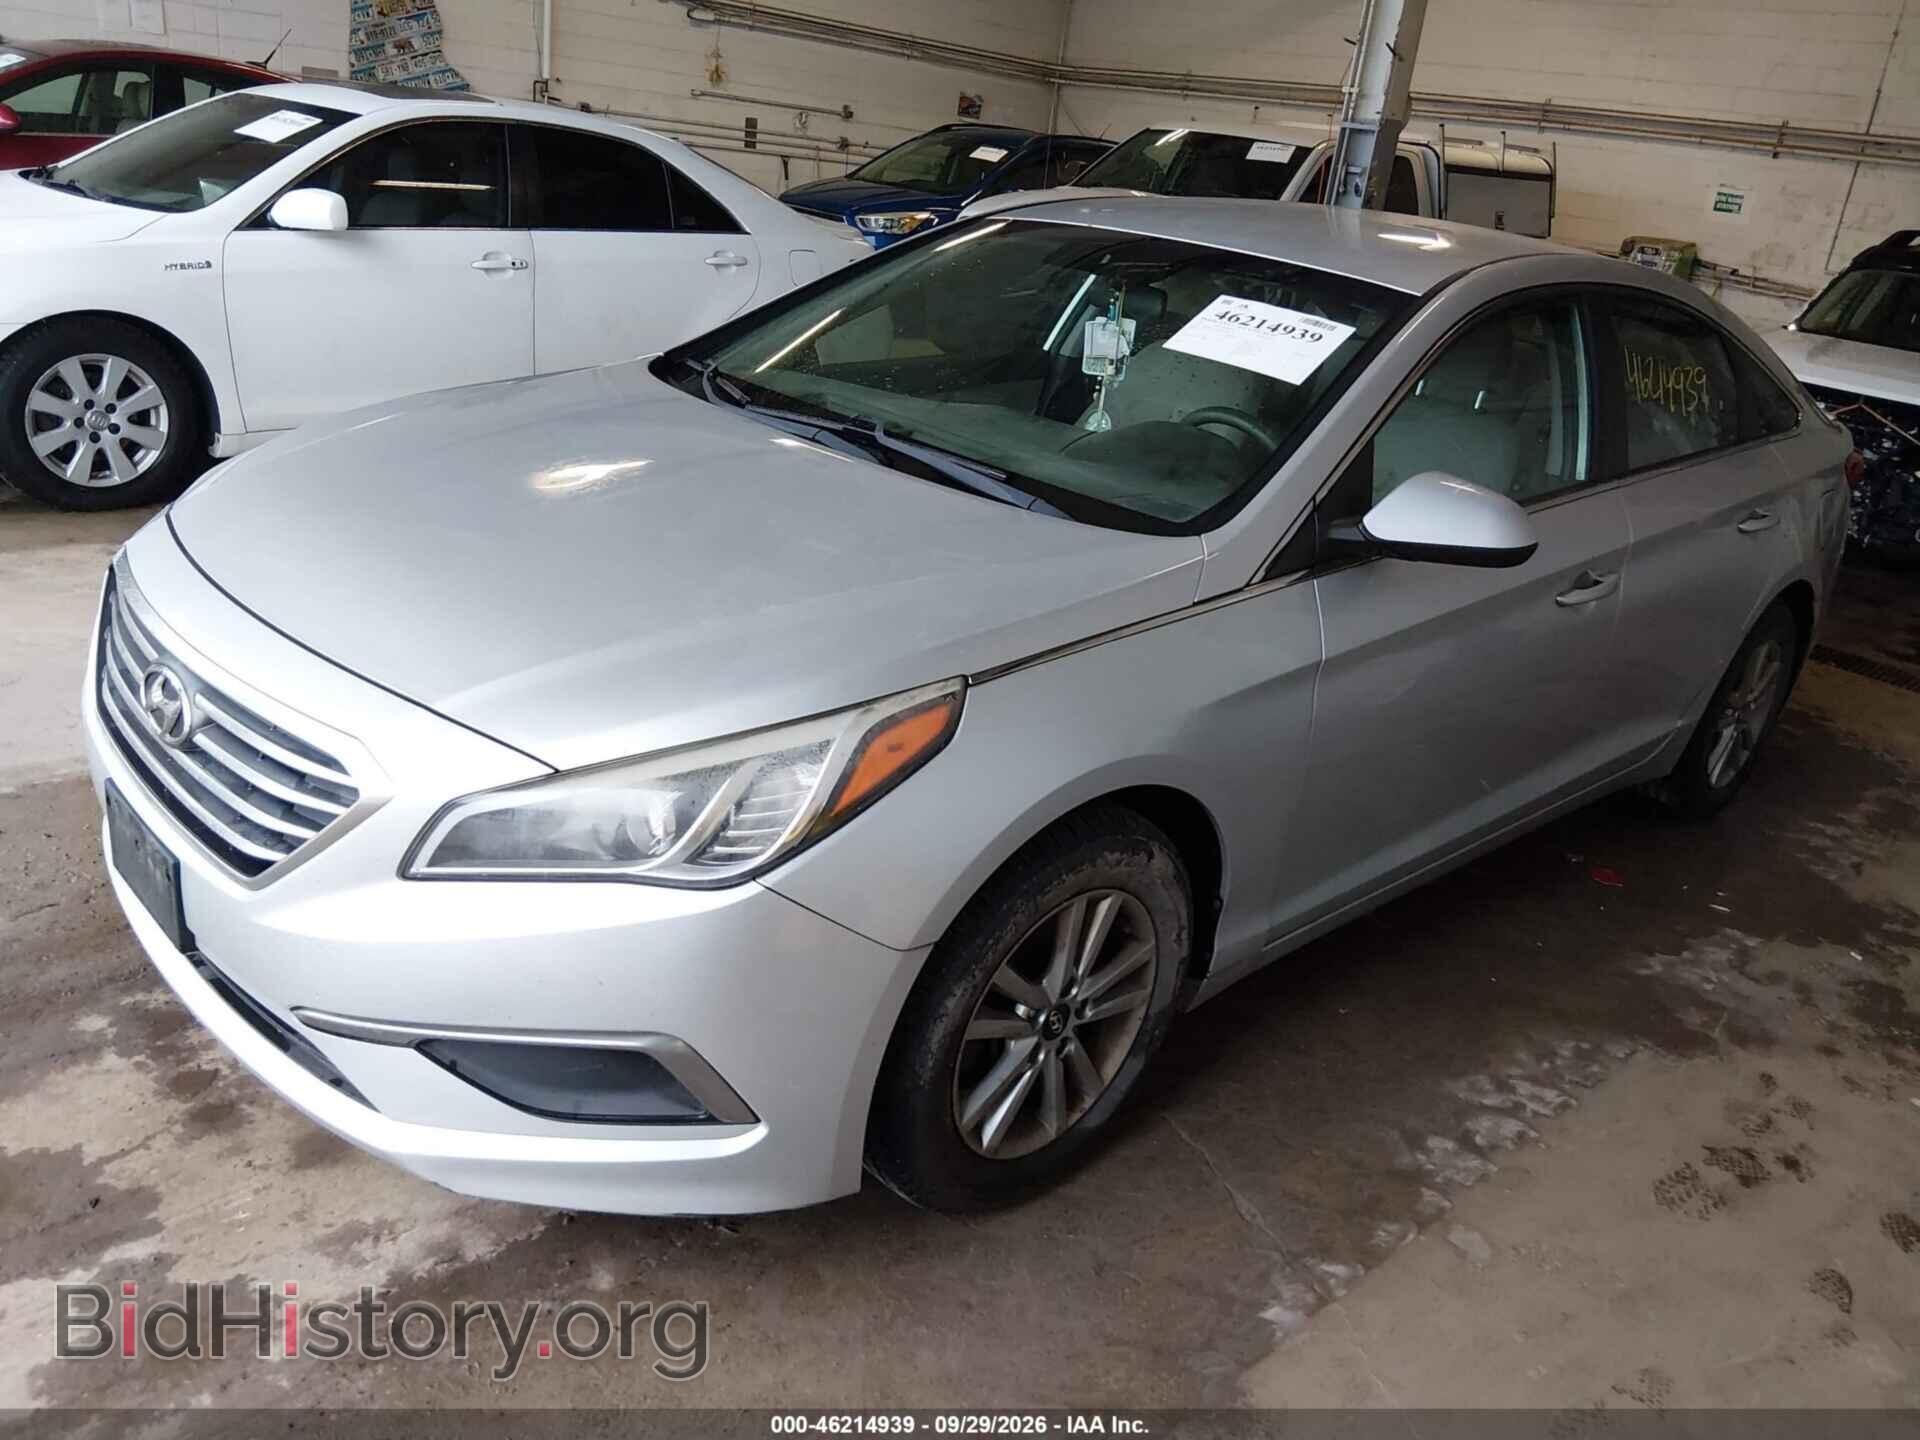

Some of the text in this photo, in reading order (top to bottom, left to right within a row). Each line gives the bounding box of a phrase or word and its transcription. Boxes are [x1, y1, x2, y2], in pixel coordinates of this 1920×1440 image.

[164, 261, 206, 271] HYBRID
[1214, 309, 1324, 344] 46214939
[1624, 344, 1710, 416] 46214939
